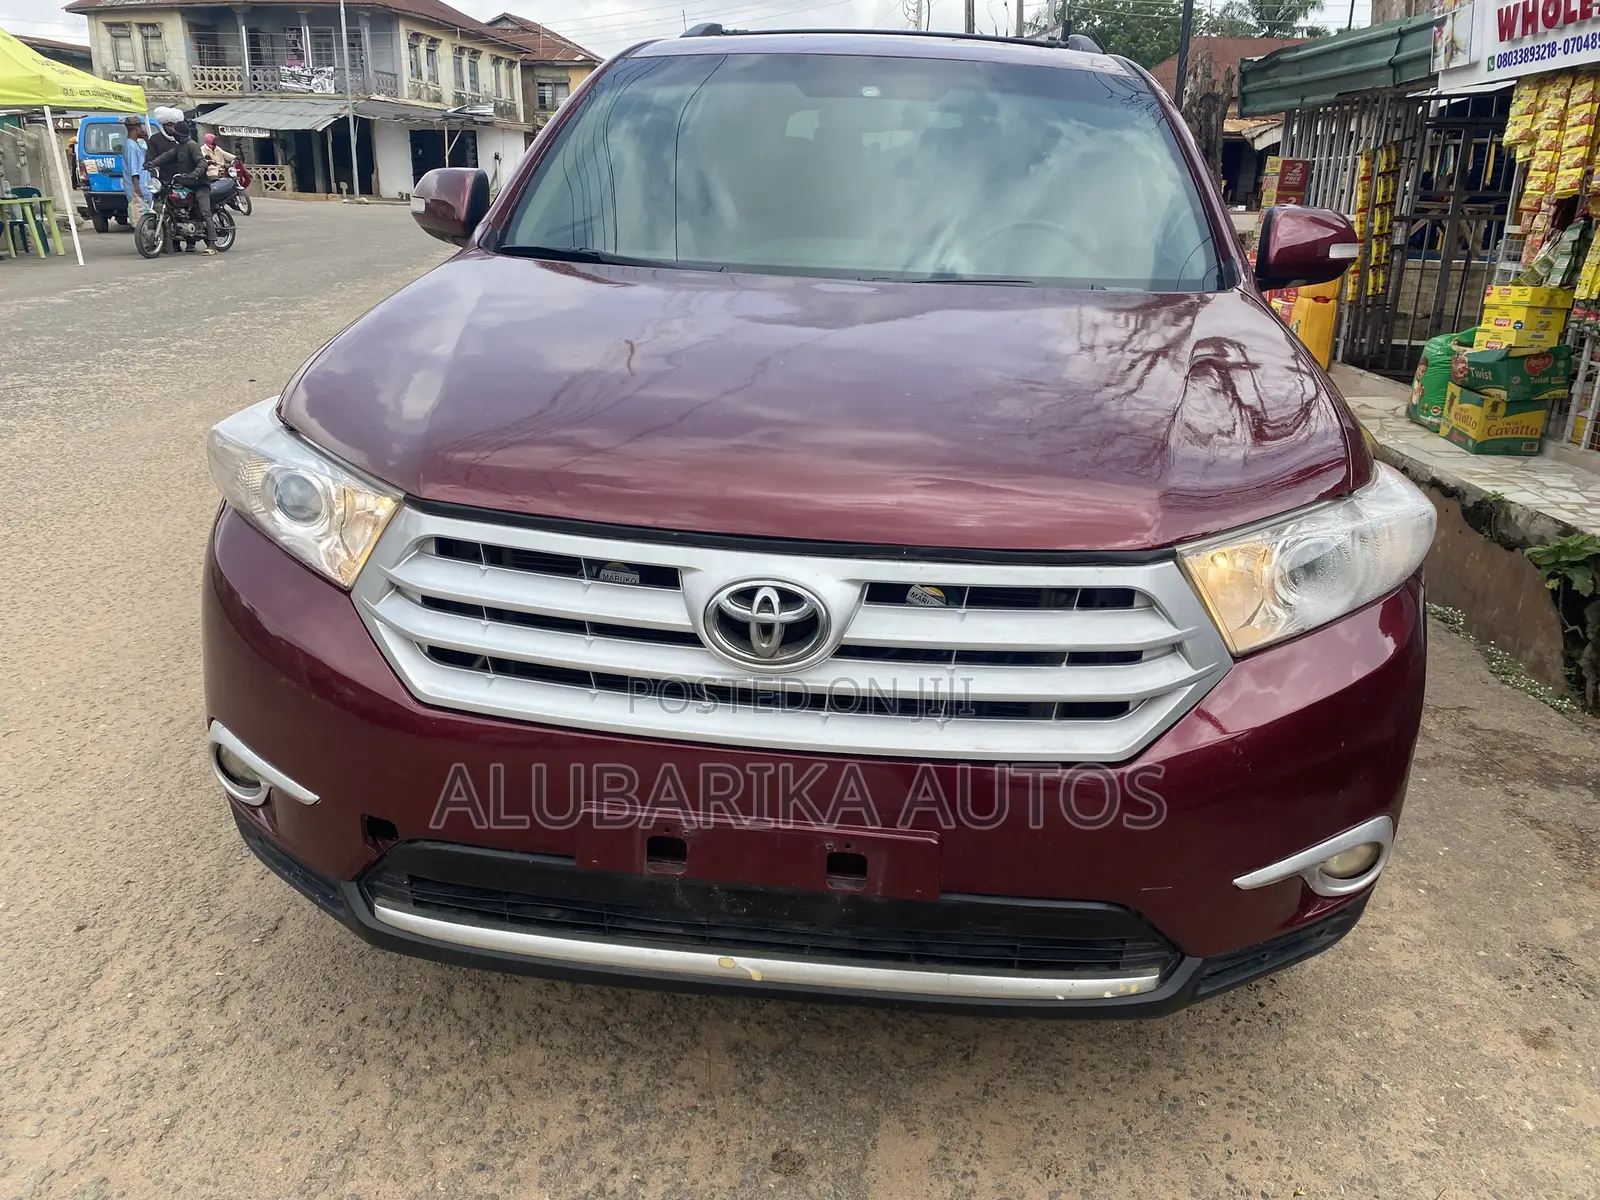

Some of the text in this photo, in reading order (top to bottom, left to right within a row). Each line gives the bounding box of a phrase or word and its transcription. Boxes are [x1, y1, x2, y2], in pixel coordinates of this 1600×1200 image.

[1497, 0, 1600, 42] WHOLE
[1496, 32, 1600, 69] 08033893218-07048
[1469, 367, 1492, 381] Twist
[1487, 423, 1538, 437] Cavatto
